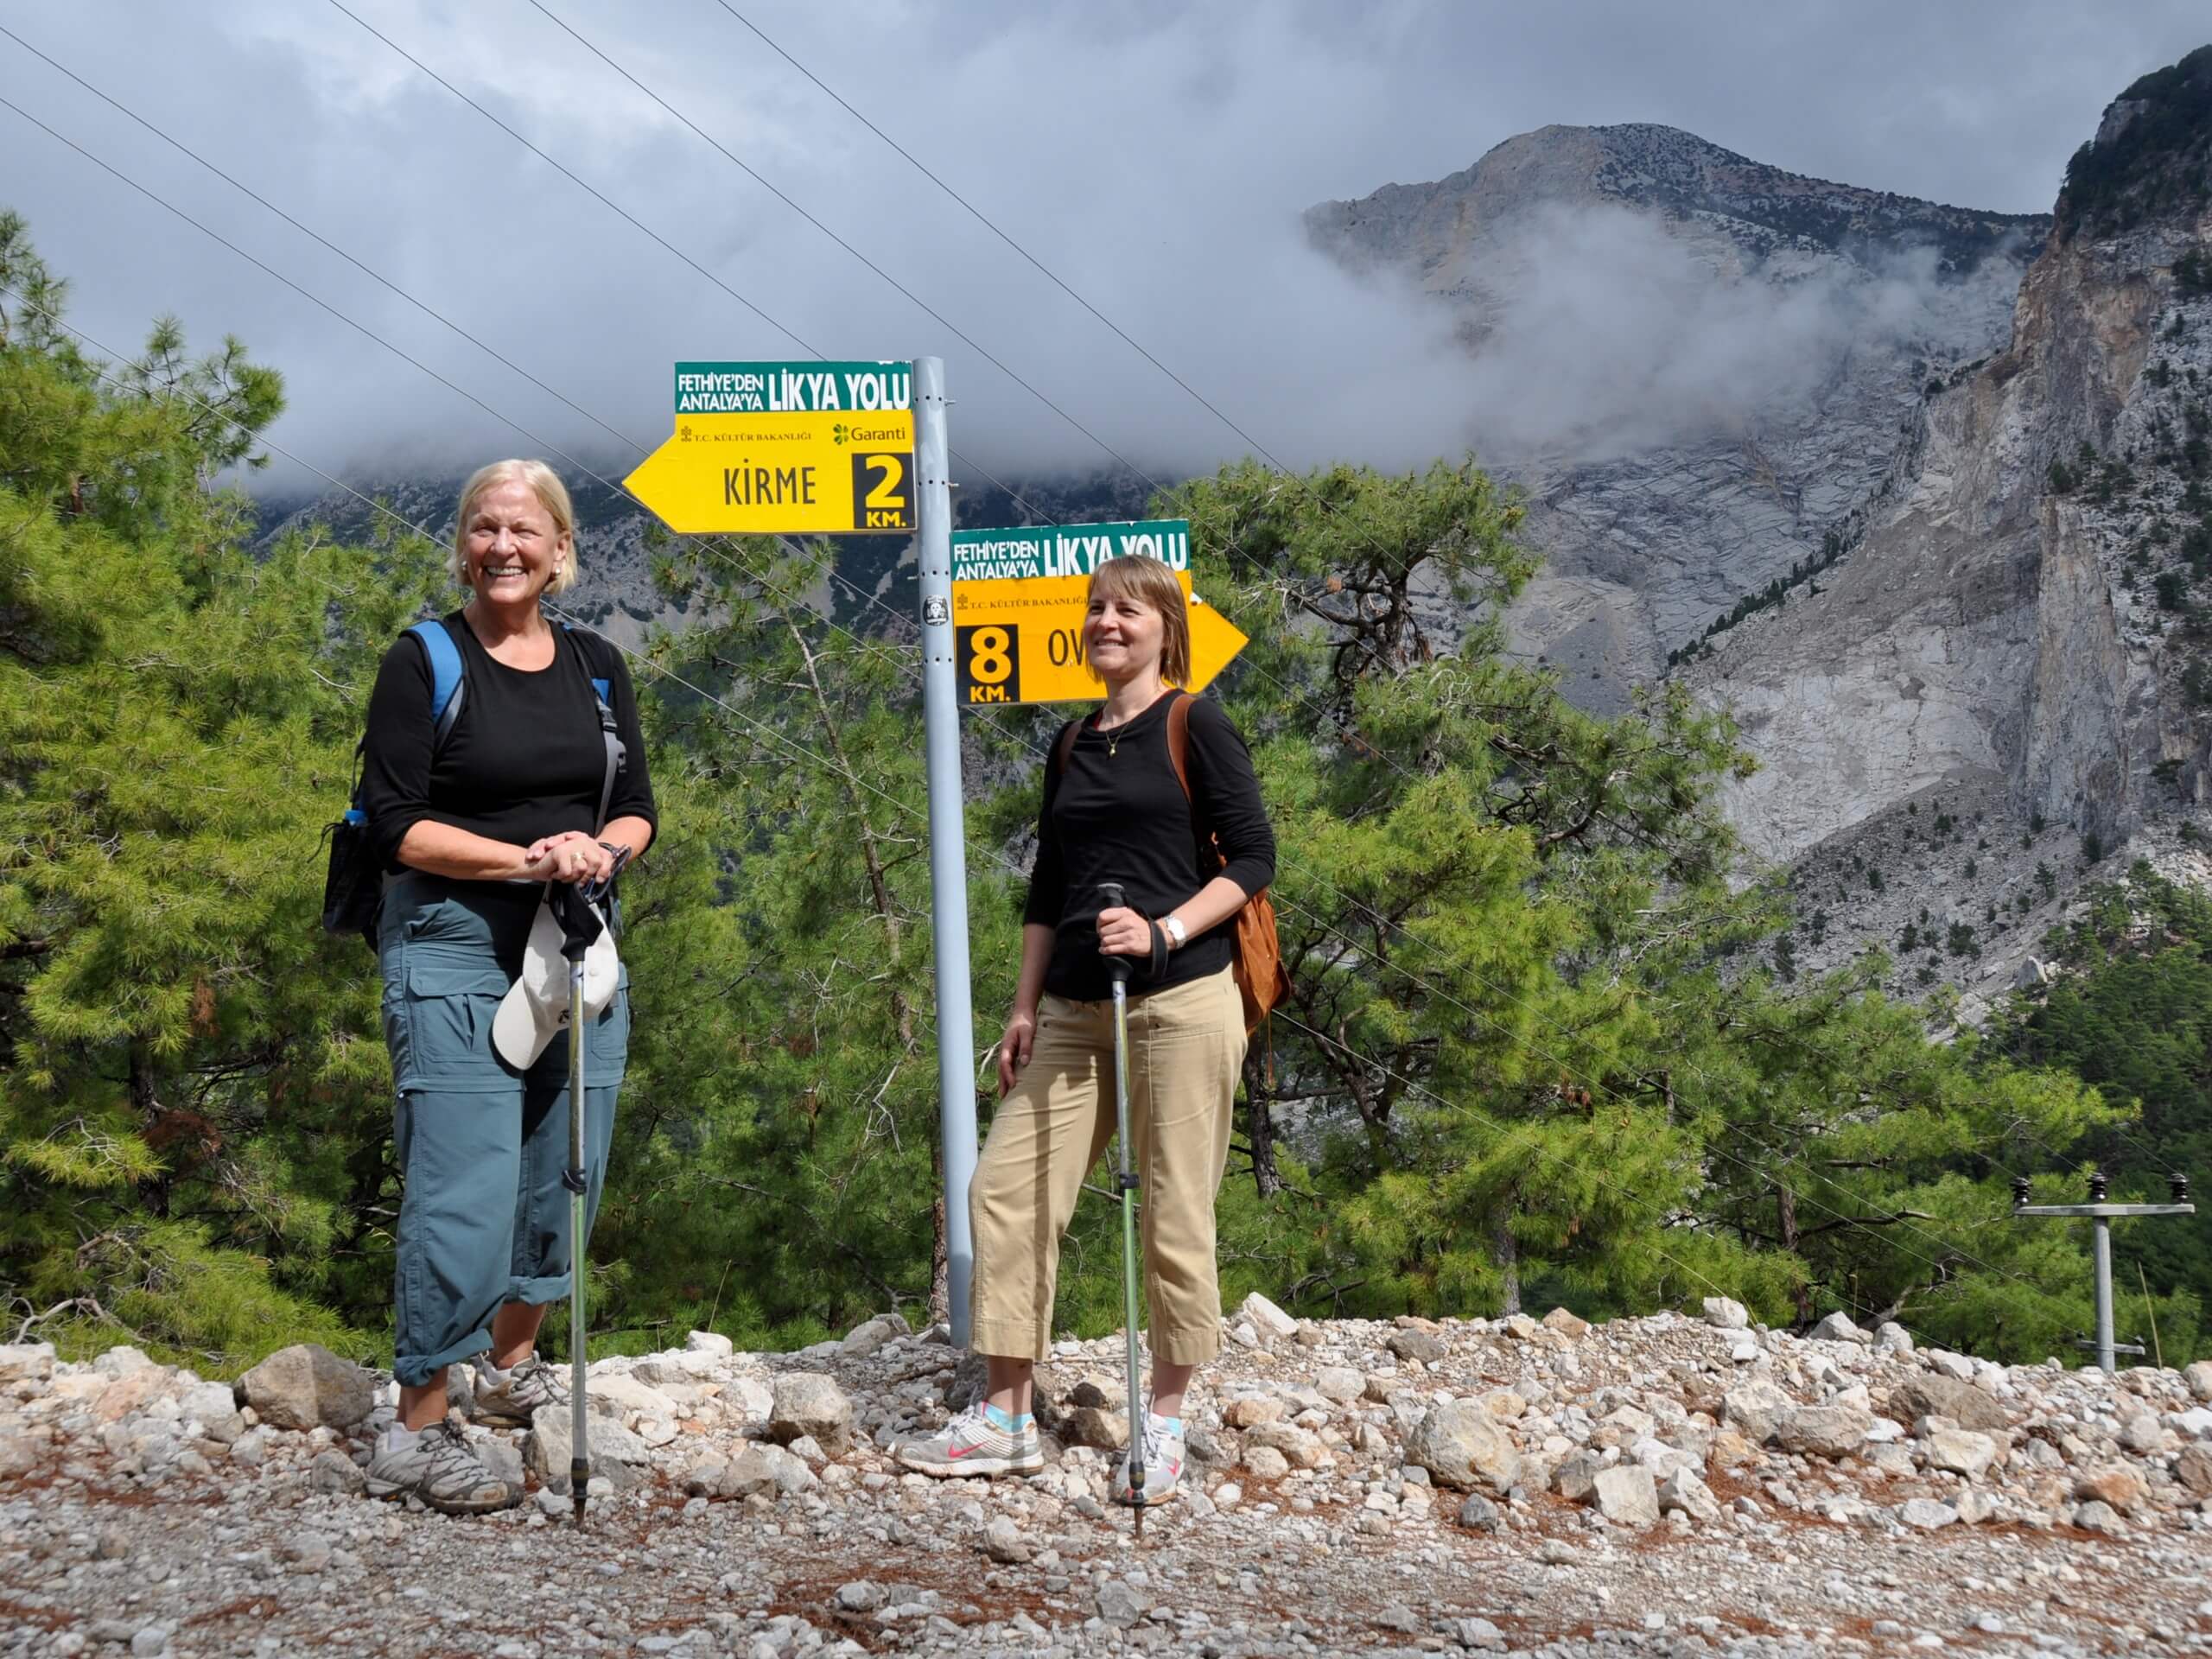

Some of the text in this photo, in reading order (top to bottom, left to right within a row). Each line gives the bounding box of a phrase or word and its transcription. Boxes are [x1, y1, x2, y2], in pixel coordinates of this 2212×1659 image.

[768, 367, 909, 411] LİKYA YOLU
[679, 392, 764, 411] ANTALYA'YA
[695, 430, 811, 442] T.C. KÜLTÜR BAKANLIĞI
[850, 427, 906, 442] Garanti
[723, 457, 817, 505] KİRME
[865, 454, 906, 508] 2
[866, 511, 906, 528] KM.
[1121, 532, 1187, 571] YOLU
[955, 560, 1039, 581] ANTALYA'YA
[970, 601, 988, 609] T.C.
[990, 598, 1030, 609] KÜLTÜR
[969, 626, 1012, 683] 8
[969, 686, 1011, 702] KM.
